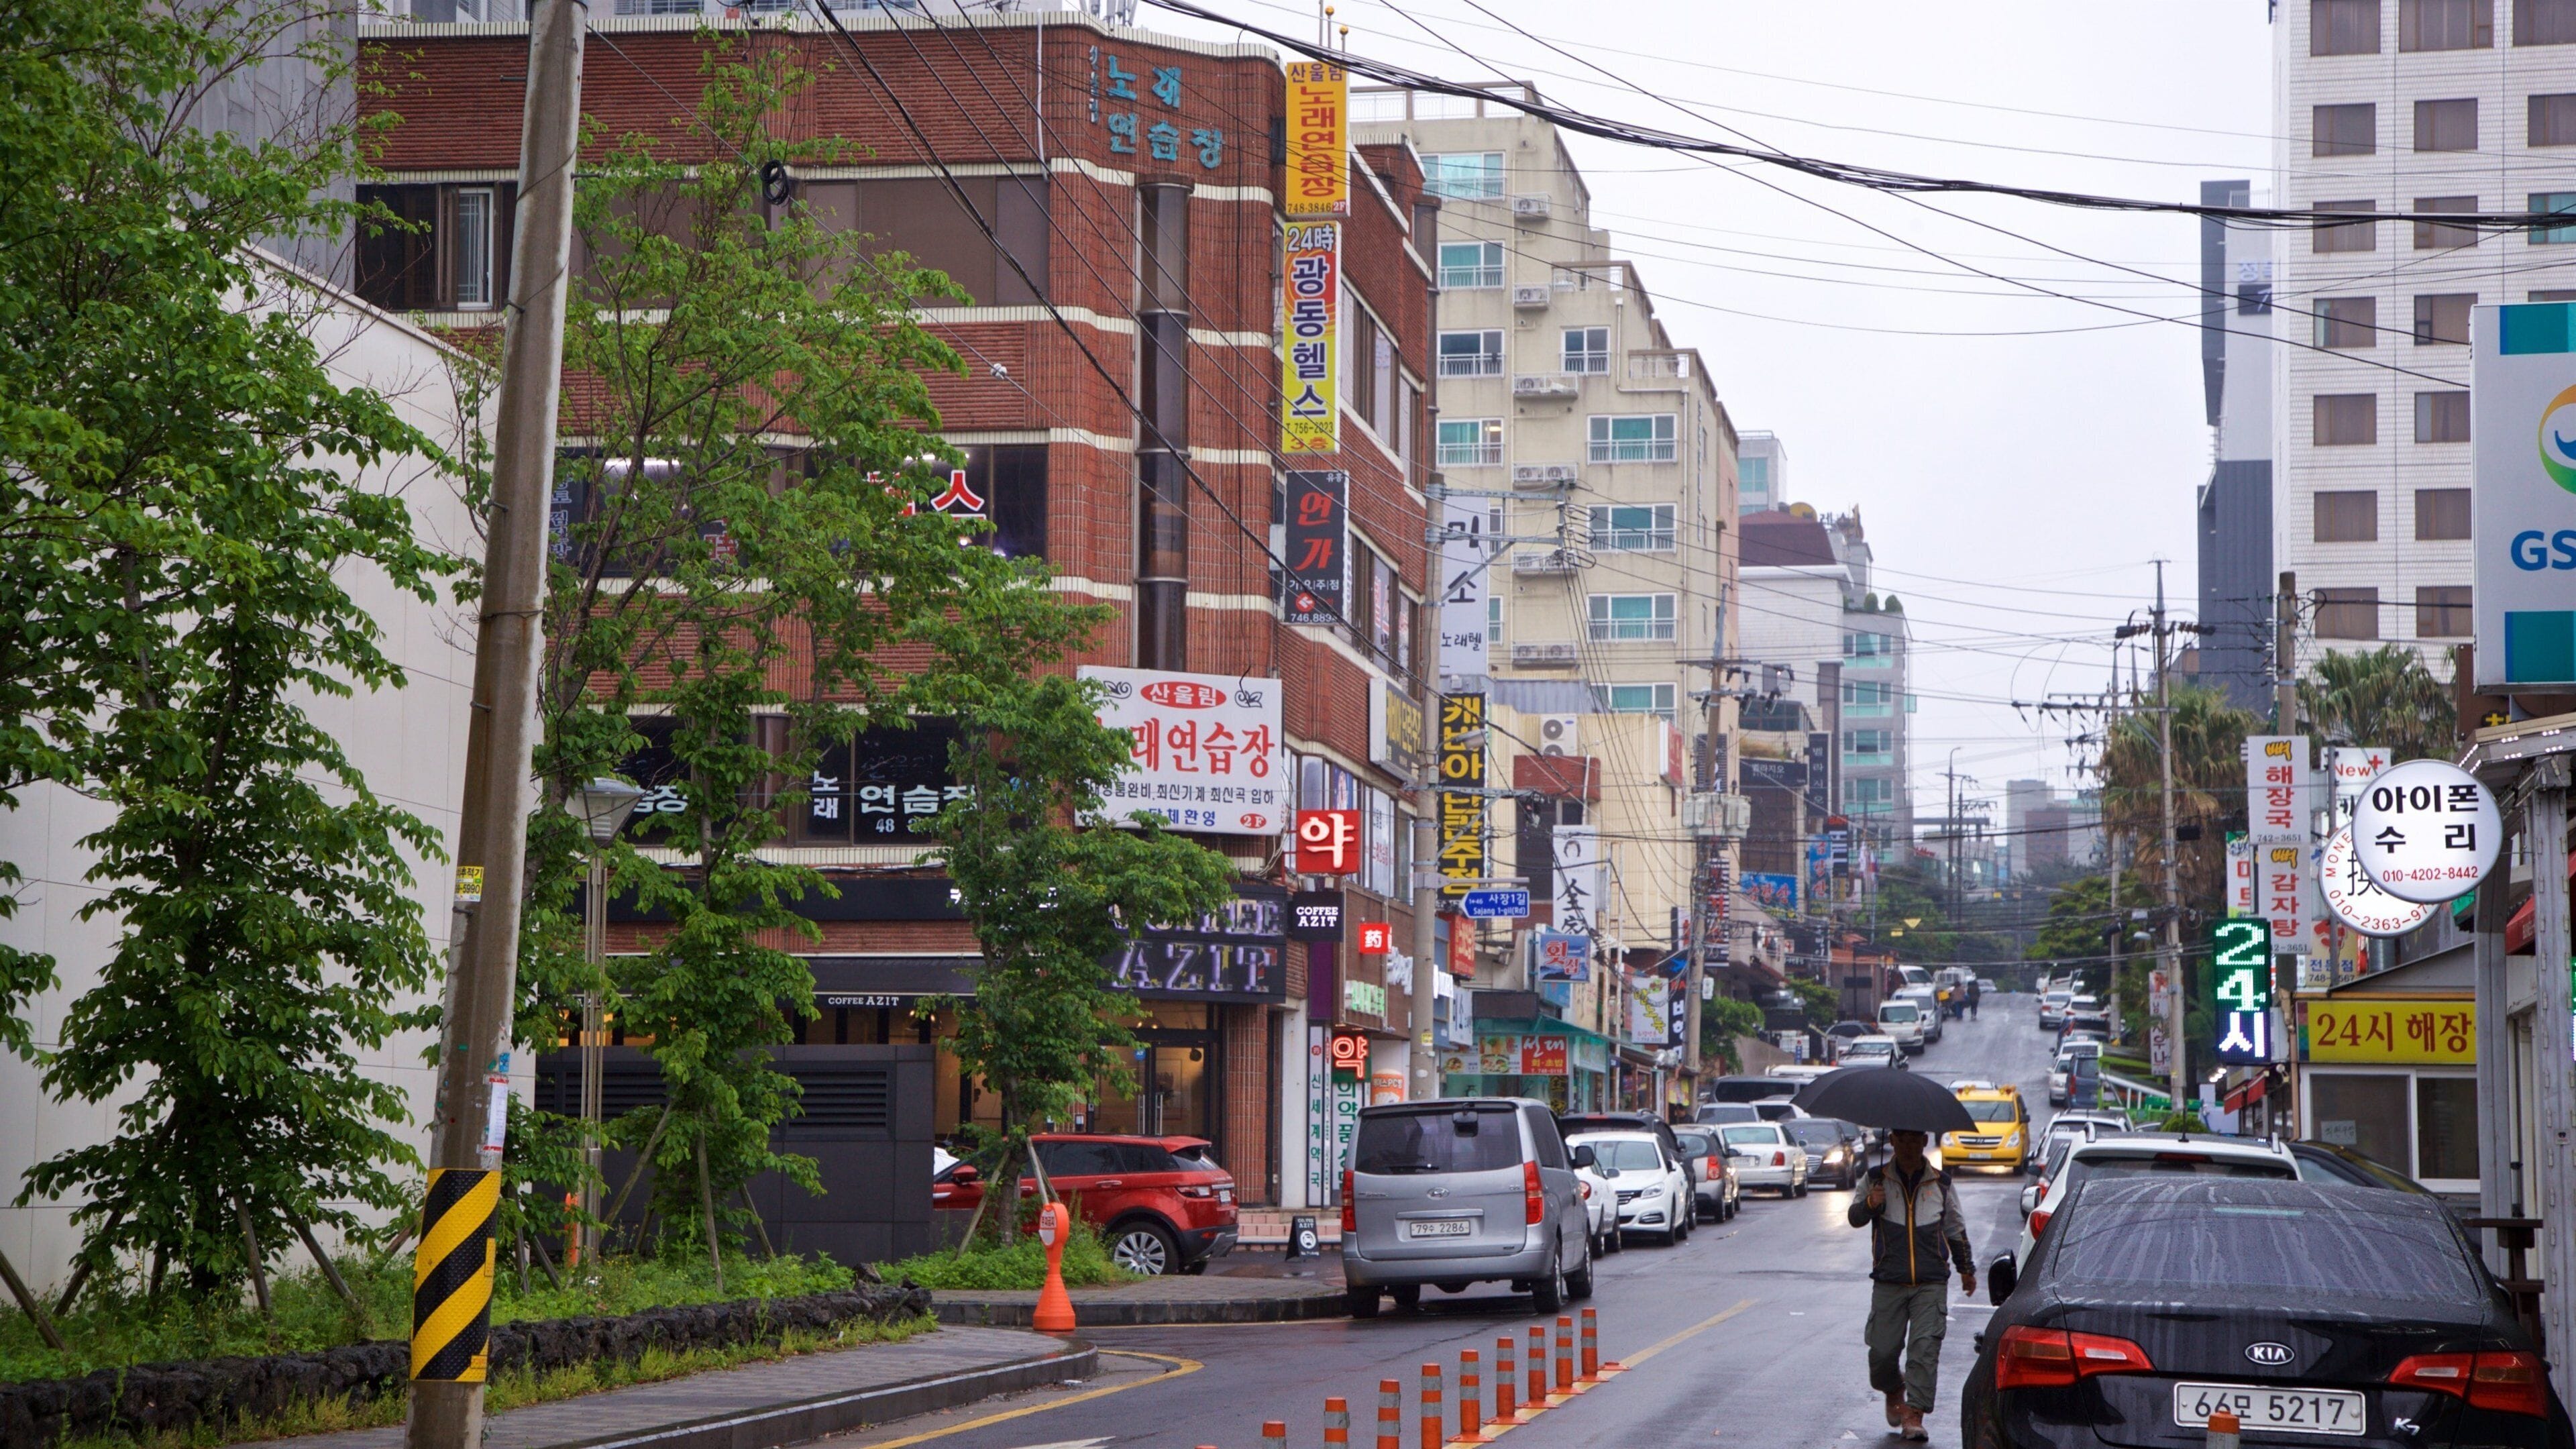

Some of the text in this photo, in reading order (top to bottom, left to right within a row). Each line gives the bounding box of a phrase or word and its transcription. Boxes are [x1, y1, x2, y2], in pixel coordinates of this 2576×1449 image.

[1106, 54, 1182, 108] 노래
[1299, 86, 1336, 197] 노래연습장
[1333, 201, 1346, 211] 2F
[1291, 256, 1328, 416] 광동헬스
[1295, 491, 1334, 571] 연가
[1447, 515, 1480, 603] 미소
[1149, 684, 1217, 706] 산울림
[1095, 716, 1276, 779] 래연습장
[2335, 763, 2371, 777] New
[812, 770, 840, 819] 노래
[1210, 788, 1246, 804] 최신곡
[1251, 789, 1275, 806] 입하
[2265, 765, 2294, 829] 해장국
[2372, 784, 2479, 814] 아이폰
[1243, 815, 1265, 828] 2F
[1300, 812, 1355, 869] 약
[2257, 834, 2302, 843] 742-3651
[2382, 865, 2479, 883] 010-4202-8442
[1295, 906, 1339, 916] COFFEE
[1472, 907, 1496, 916] Sajang
[1488, 893, 1526, 906] 사장1길
[2271, 873, 2300, 937] 감자탕
[1297, 916, 1337, 927] AZIT
[1112, 940, 1278, 992] AZIT
[828, 996, 900, 1006] COFFEE AZIT
[2216, 922, 2267, 1058] 24시
[2317, 1012, 2476, 1053] 24시 해장
[1332, 1035, 1369, 1081] 약
[1311, 1074, 1322, 1187] 신세계약국
[1439, 1224, 1465, 1234] 2286
[2253, 1346, 2287, 1360] KIA
[2194, 1391, 2345, 1426] 66모 5217
[2394, 1416, 2420, 1436] K7
